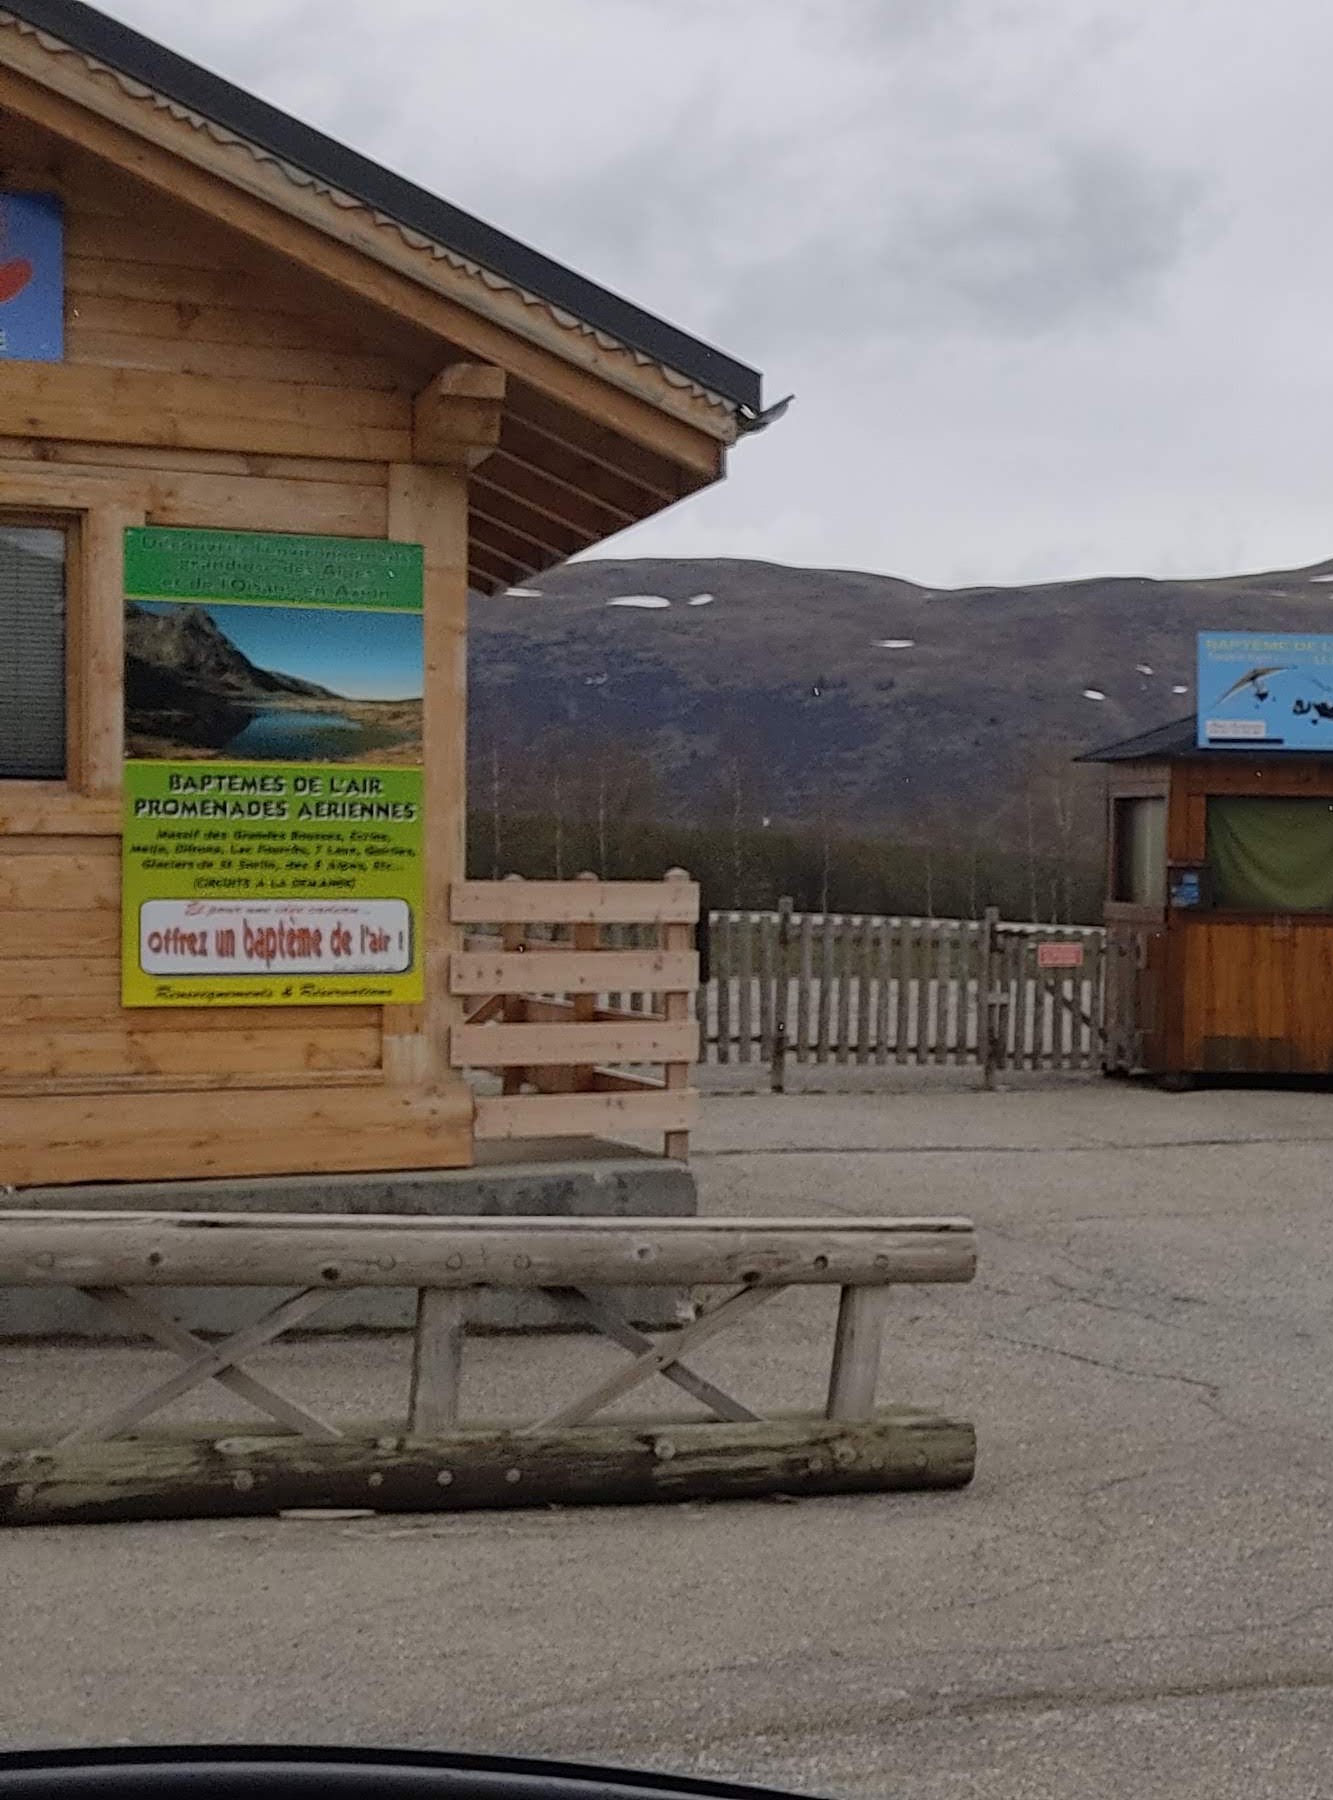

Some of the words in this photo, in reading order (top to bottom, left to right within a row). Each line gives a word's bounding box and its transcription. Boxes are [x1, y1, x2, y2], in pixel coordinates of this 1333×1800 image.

[293, 776, 324, 796] DE
[329, 776, 384, 798] L'AIR
[133, 798, 289, 822] PROMENADES
[297, 800, 417, 824] AERIENNES
[203, 830, 227, 841] des
[215, 927, 236, 958] un
[329, 920, 352, 958] de
[360, 923, 391, 955] l'air
